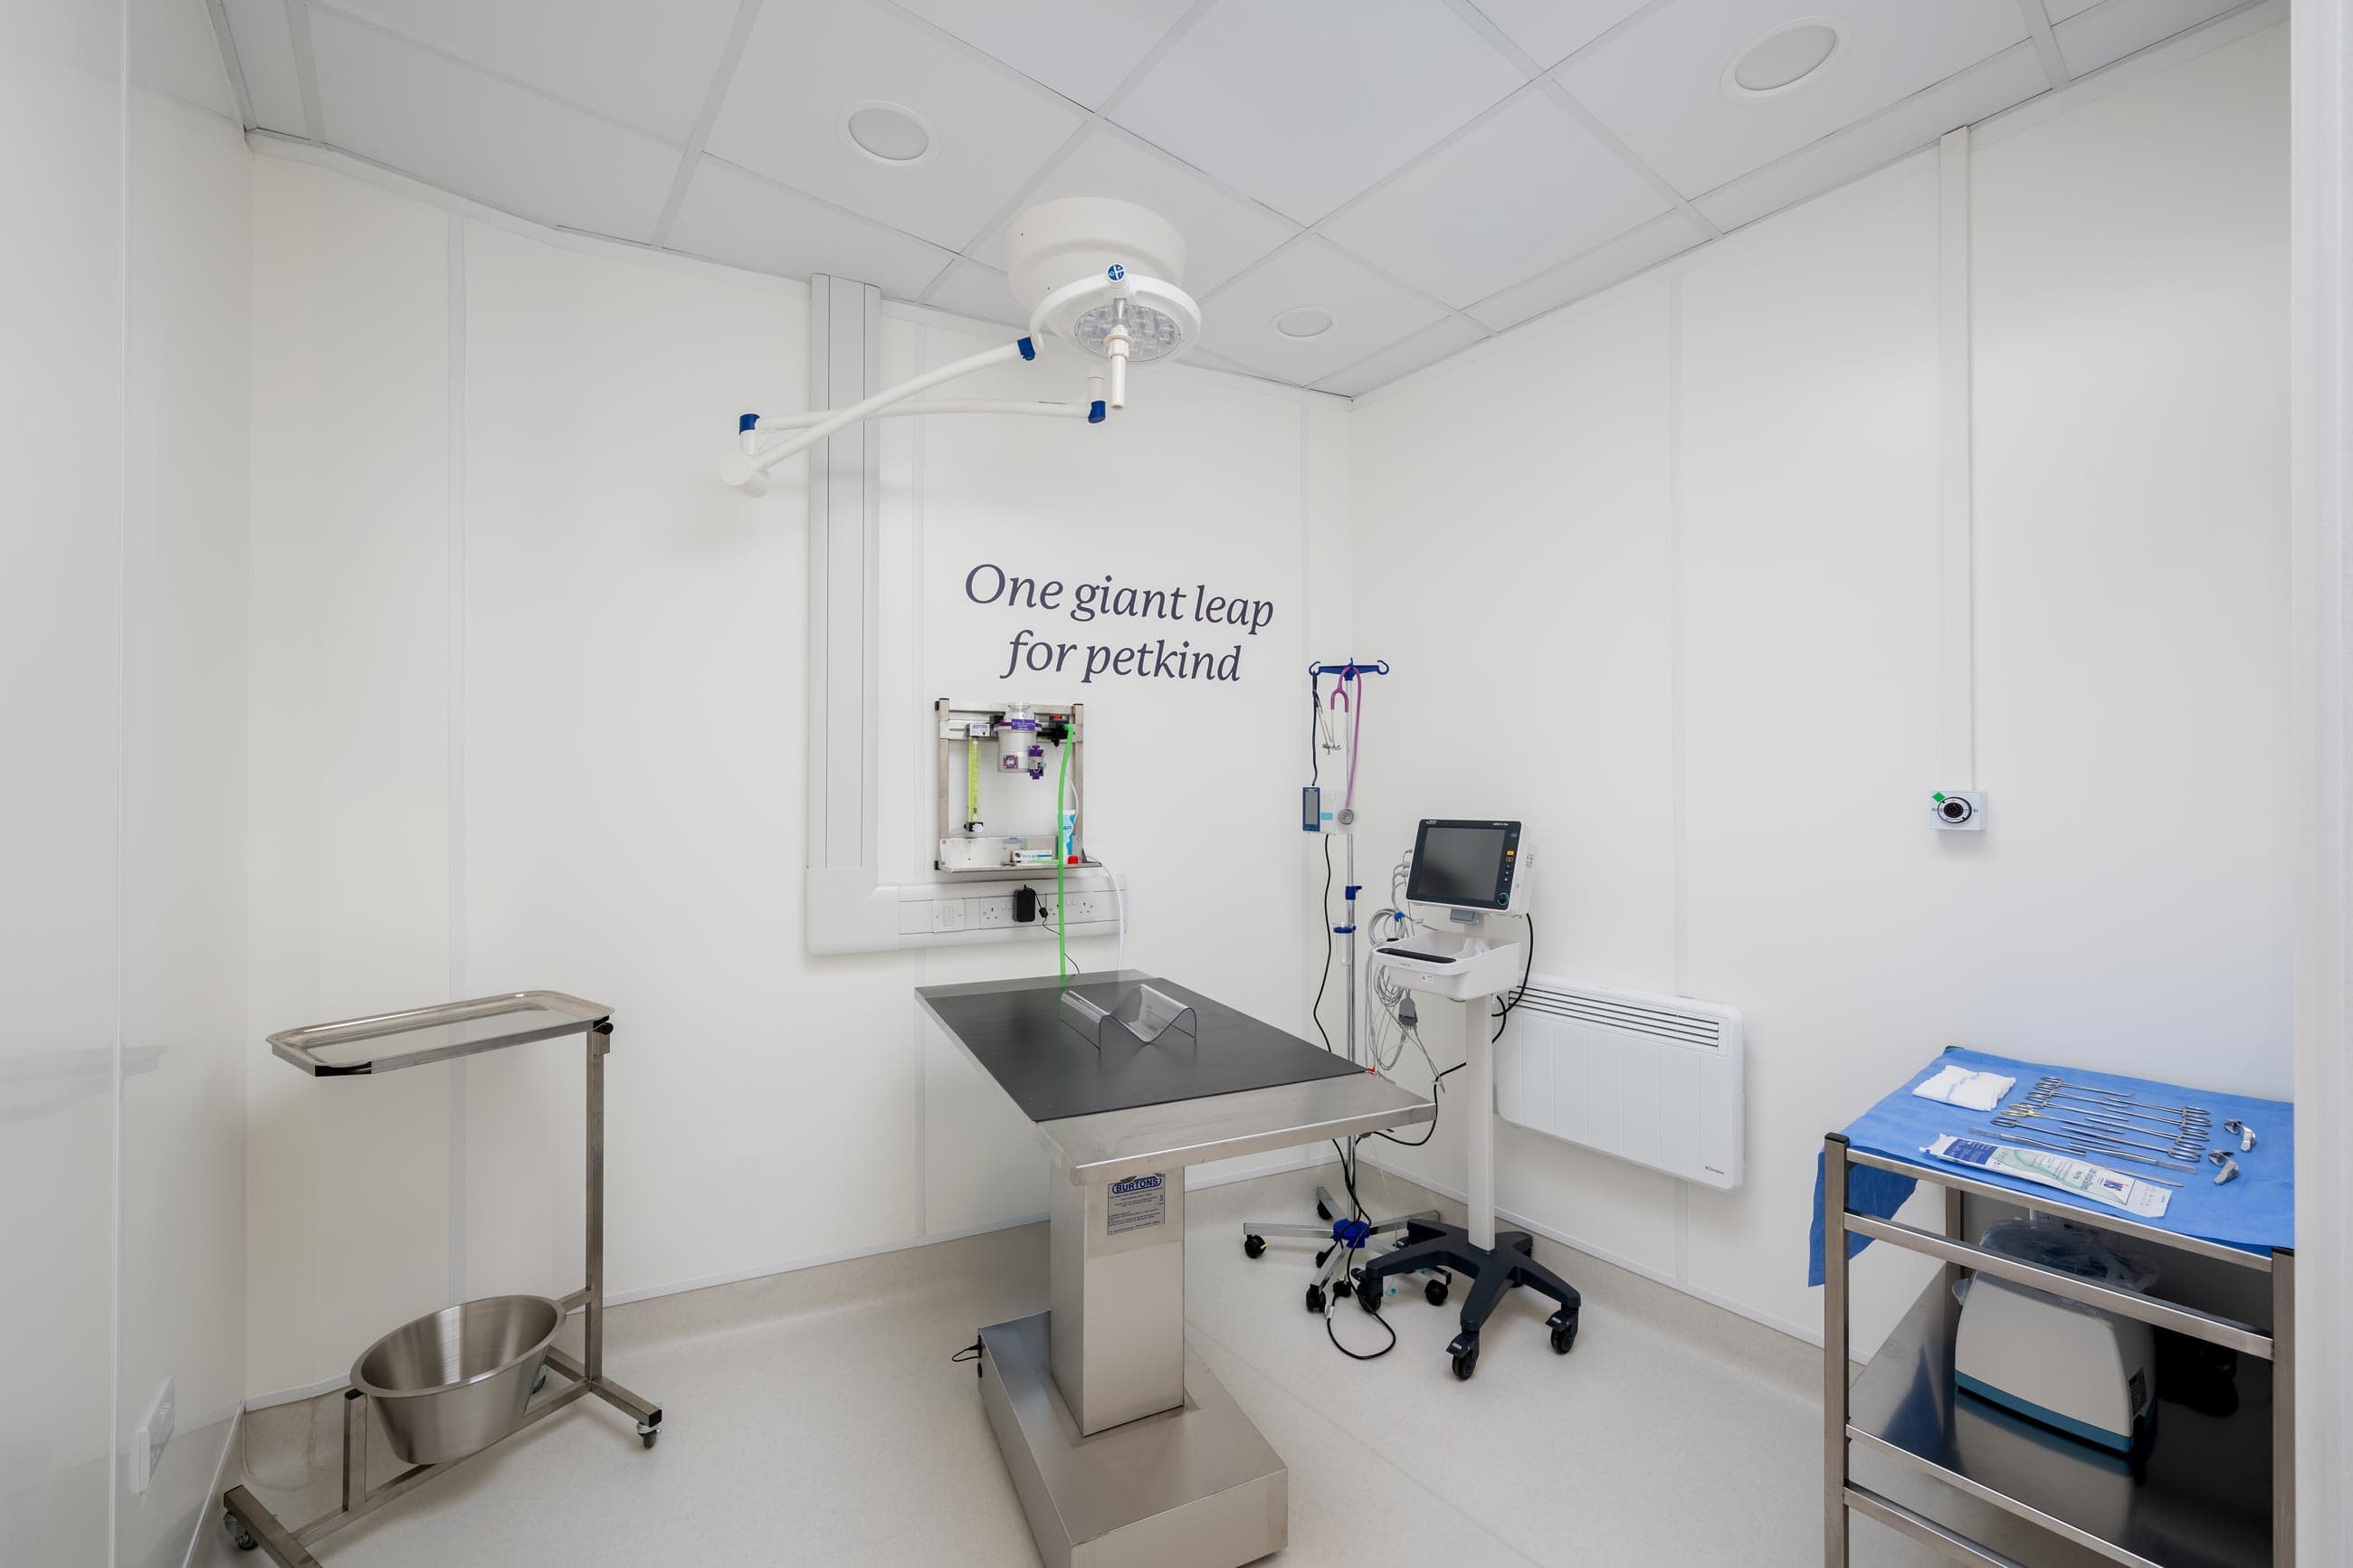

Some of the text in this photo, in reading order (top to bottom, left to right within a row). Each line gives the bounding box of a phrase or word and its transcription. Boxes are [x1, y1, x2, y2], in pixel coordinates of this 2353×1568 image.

[965, 564, 1274, 636] One giant leap
[999, 629, 1242, 684] for petkind
[1116, 1178, 1158, 1192] BURTONS
